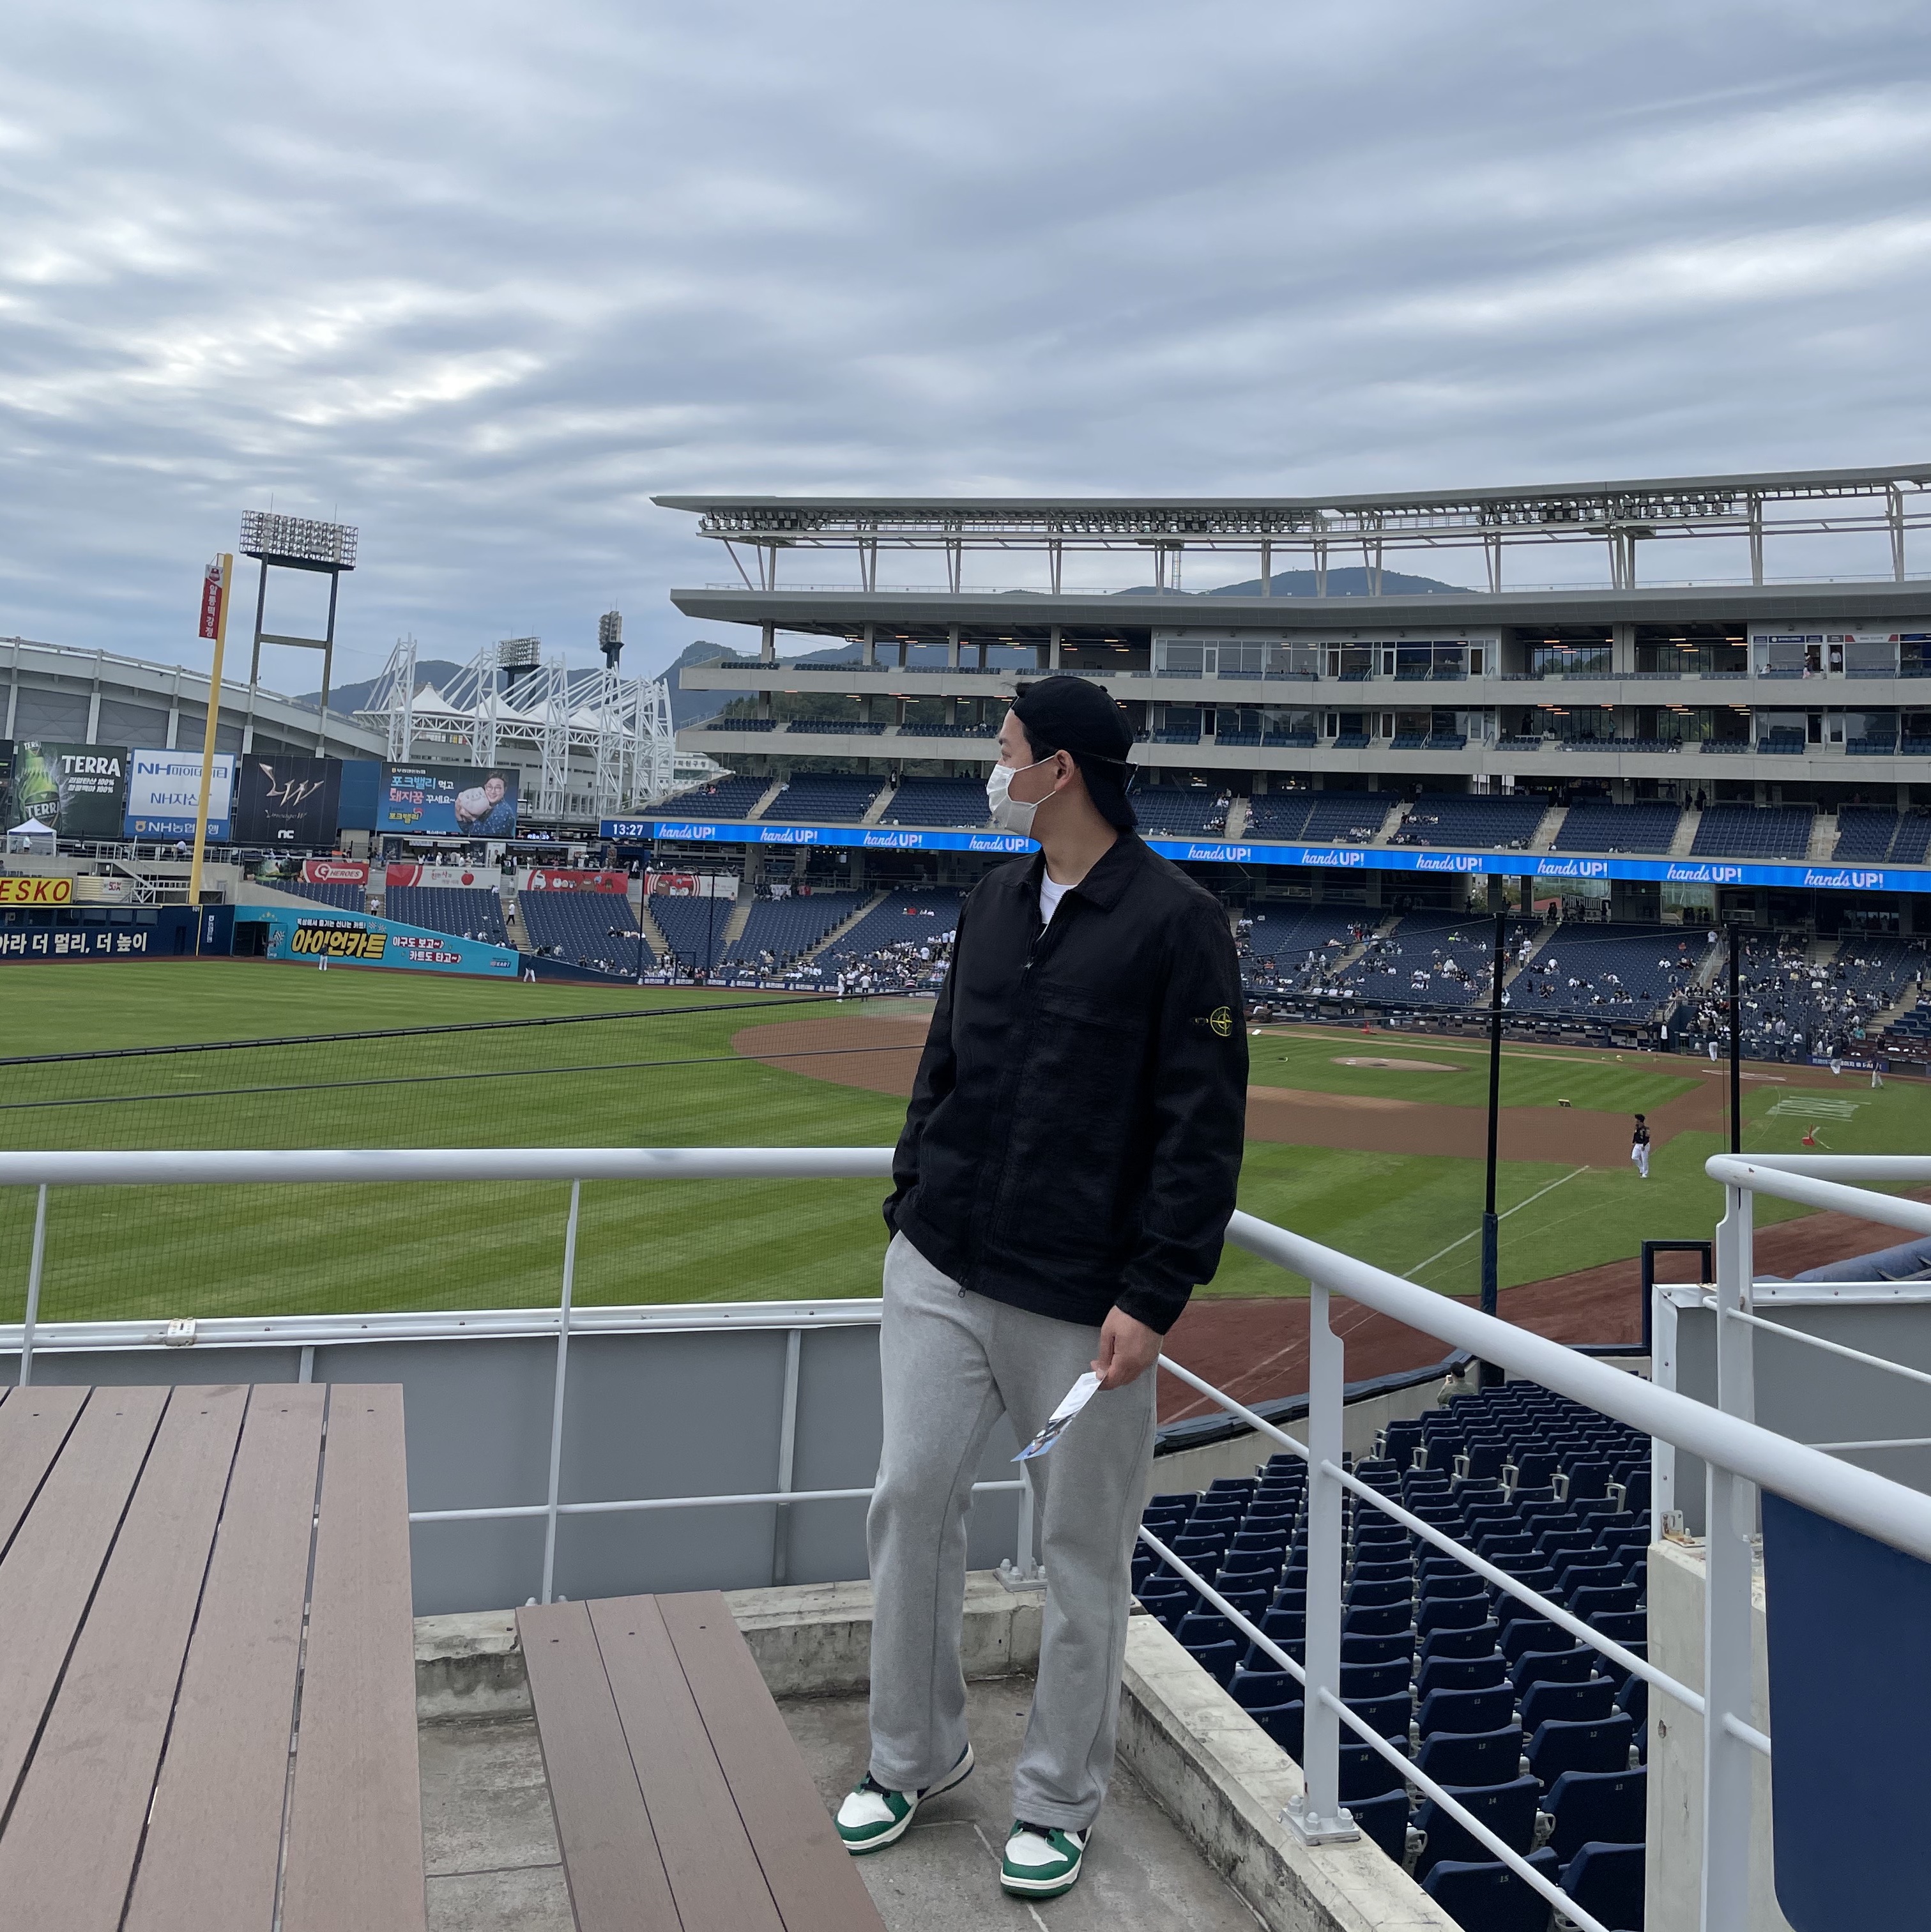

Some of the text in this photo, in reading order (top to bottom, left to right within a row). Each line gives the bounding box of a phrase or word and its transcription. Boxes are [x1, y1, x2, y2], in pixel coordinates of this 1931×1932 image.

[61, 755, 121, 778] TERRA
[96, 785, 114, 794] 100%
[98, 778, 114, 786] 100%
[390, 776, 454, 790] 포크밸리 먹고
[389, 788, 424, 804] 돼지꿈
[388, 812, 420, 824] 포크밸리
[148, 822, 219, 835] NH농협행
[613, 824, 643, 836] 13:27
[659, 824, 715, 839] hands UP!
[760, 827, 818, 843] hands UP!
[864, 831, 922, 847] hands UP!
[969, 835, 1029, 851] hands UP!
[1187, 844, 1251, 861] hands UP!
[1301, 848, 1364, 866] hands UP!
[1416, 854, 1483, 871] hands UP!
[1538, 859, 1608, 877] hands UP!
[1667, 864, 1742, 882] hands UP!
[1805, 870, 1883, 889] hands UP!
[0, 880, 70, 901] ESKO
[33, 933, 49, 954] 더
[55, 933, 90, 954] 멀리,
[96, 933, 112, 953] 더
[117, 932, 148, 952] 높이
[292, 930, 386, 958] 아이언카트
[392, 936, 416, 948] 야구도
[409, 950, 433, 962] 카트도
